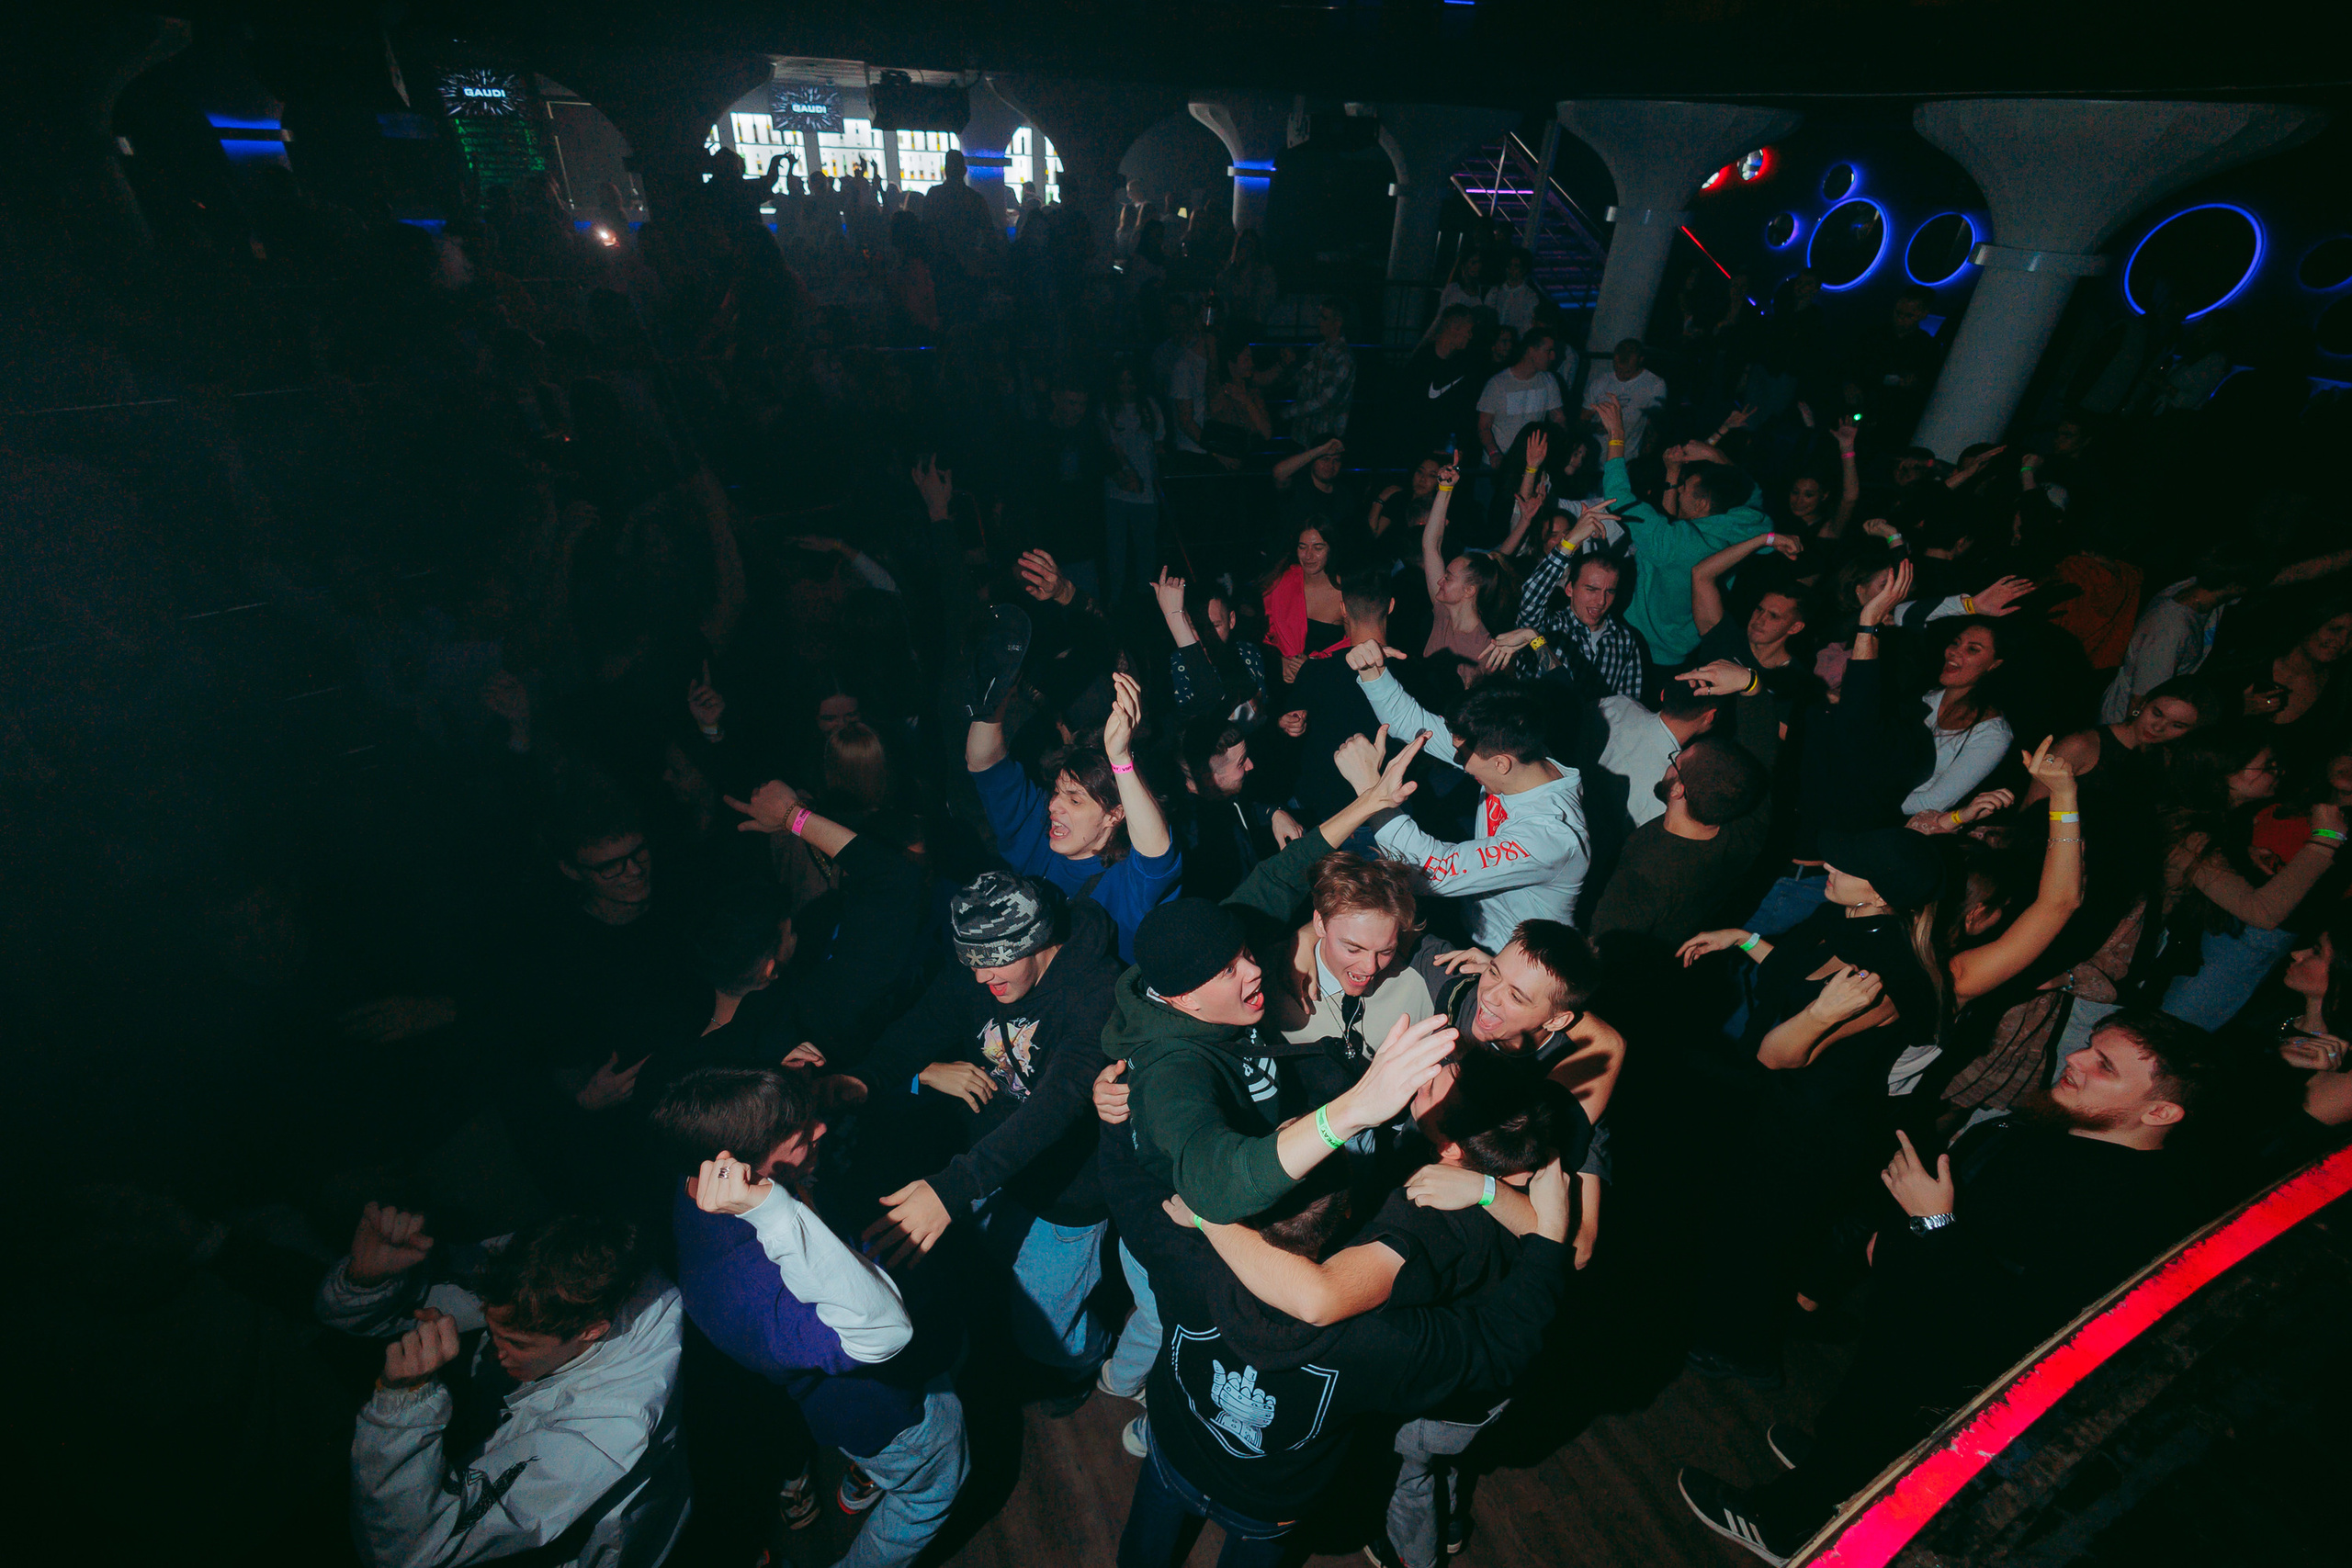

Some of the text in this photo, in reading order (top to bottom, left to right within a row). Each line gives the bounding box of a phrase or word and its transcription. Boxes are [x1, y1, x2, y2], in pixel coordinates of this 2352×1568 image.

[463, 87, 506, 98] GAUDI
[792, 103, 827, 114] GAUDI
[1476, 841, 1530, 869] 1981
